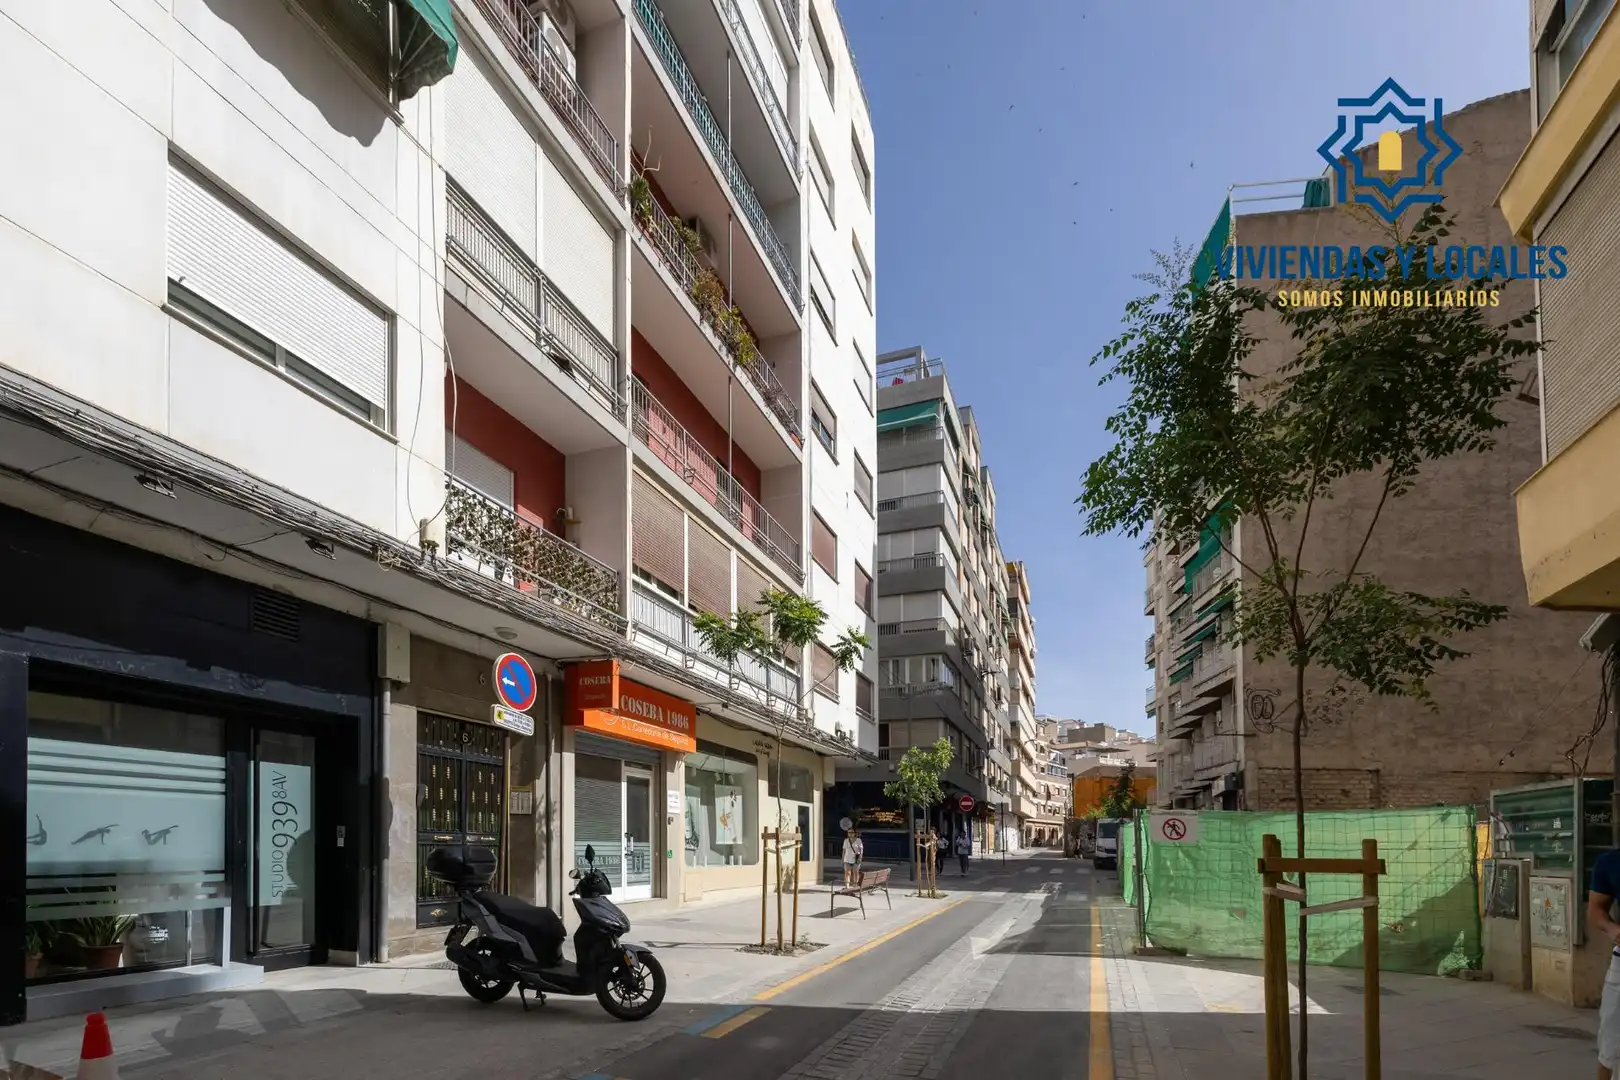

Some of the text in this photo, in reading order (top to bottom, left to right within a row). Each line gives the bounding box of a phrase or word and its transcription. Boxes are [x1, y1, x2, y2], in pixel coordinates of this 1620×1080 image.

[580, 675, 611, 686] COSEBA
[620, 694, 689, 730] COSEBA 1986
[462, 733, 469, 743] 6
